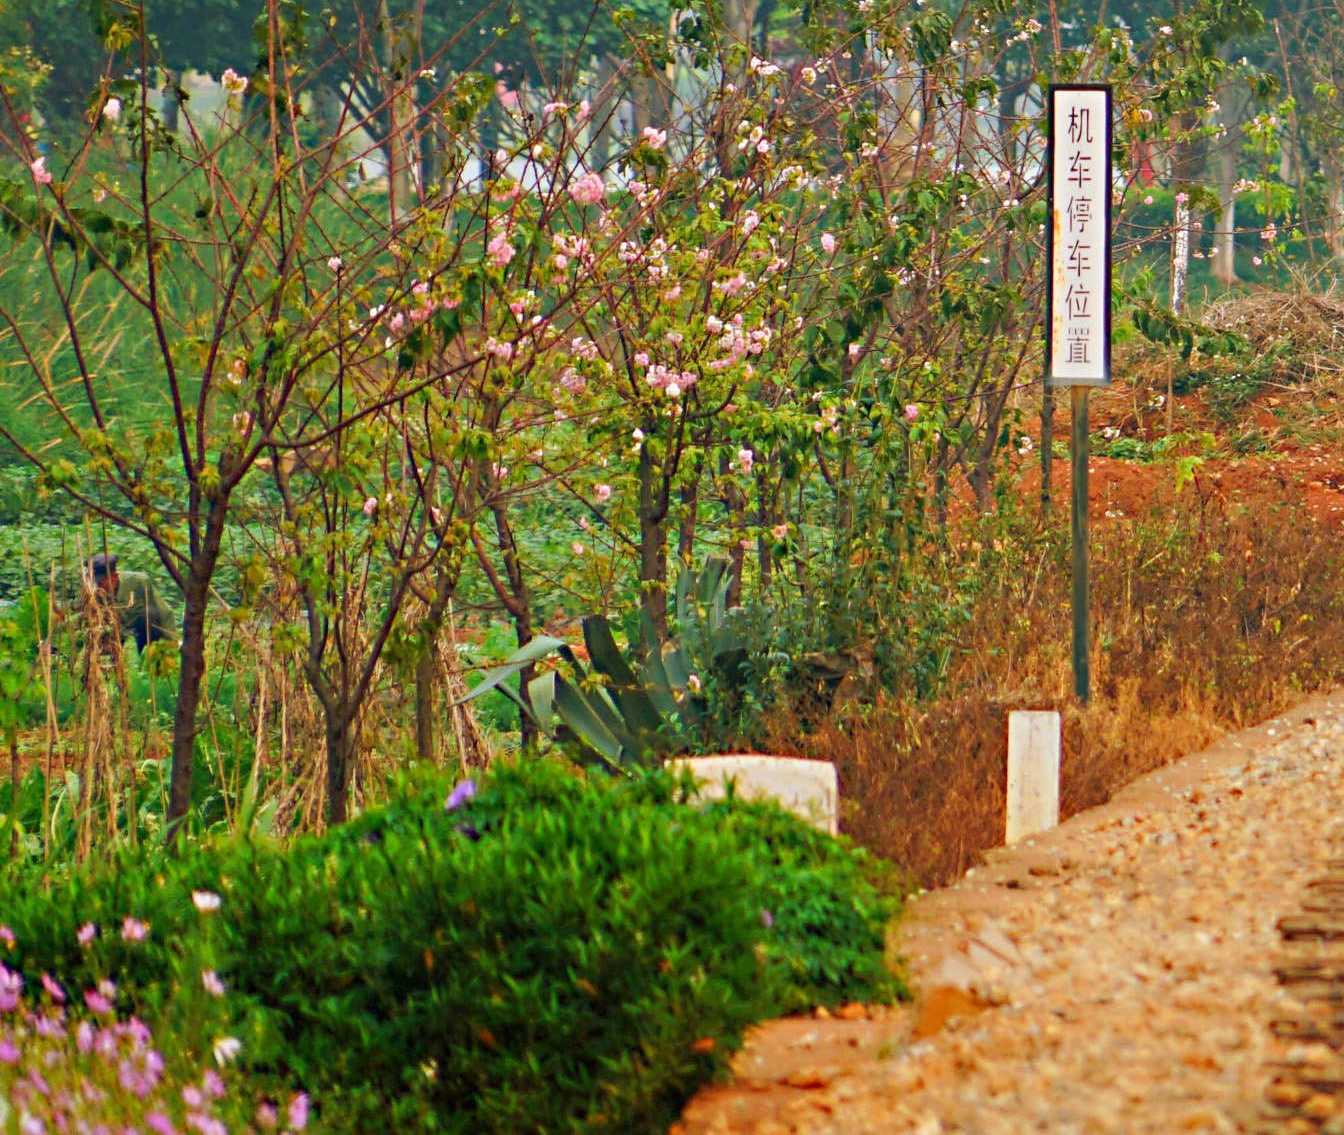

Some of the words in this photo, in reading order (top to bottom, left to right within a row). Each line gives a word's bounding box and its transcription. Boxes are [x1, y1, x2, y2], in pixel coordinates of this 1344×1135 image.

[1065, 106, 1093, 364] 机车停车位置
